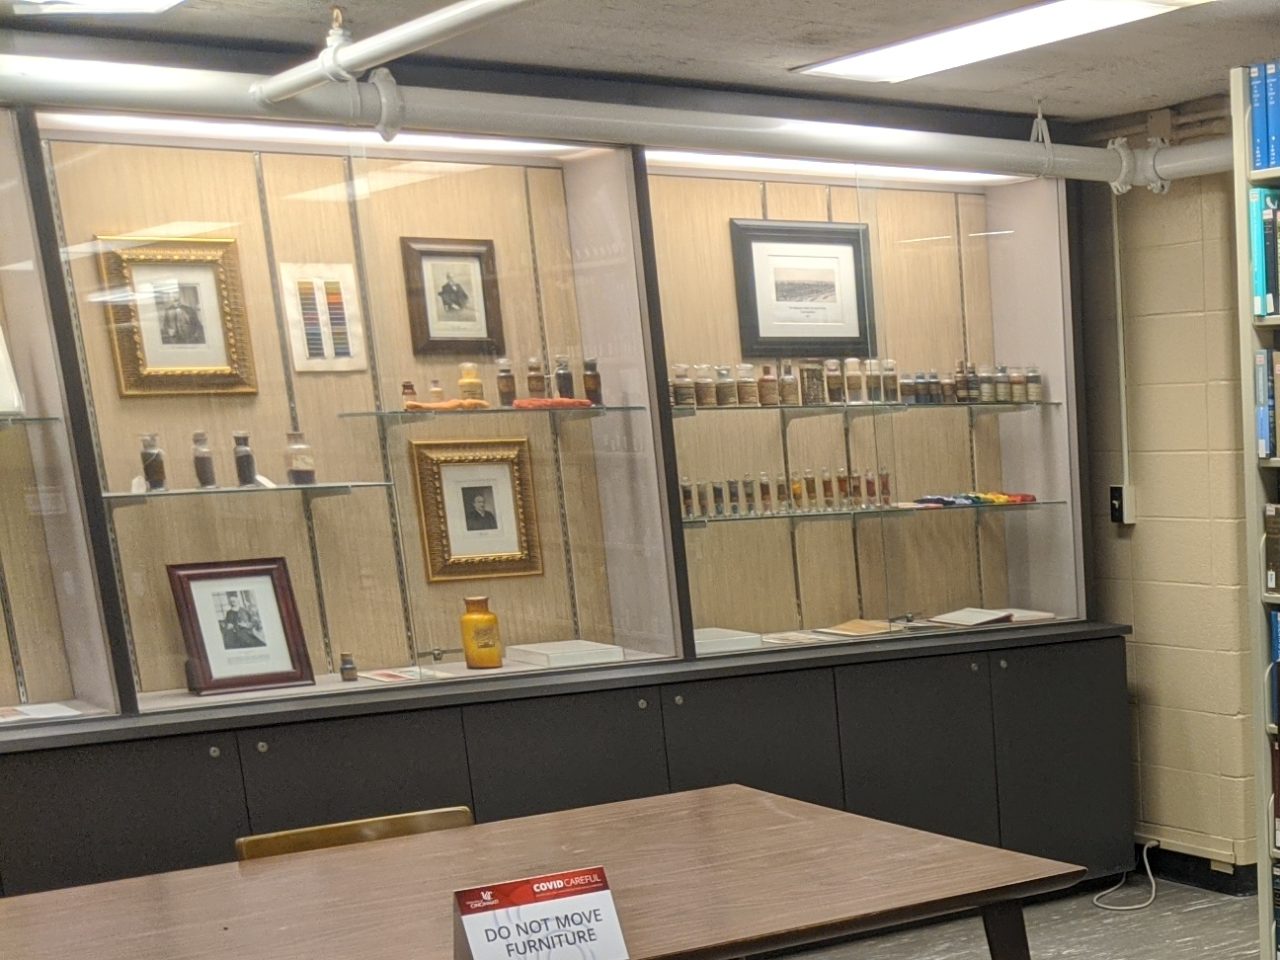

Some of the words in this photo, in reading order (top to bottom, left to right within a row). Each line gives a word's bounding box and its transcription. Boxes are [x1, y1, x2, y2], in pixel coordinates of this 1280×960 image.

[484, 926, 511, 943] DO
[515, 917, 550, 937] NOT
[555, 908, 603, 929] MOVE
[505, 928, 597, 957] FURNITURE
